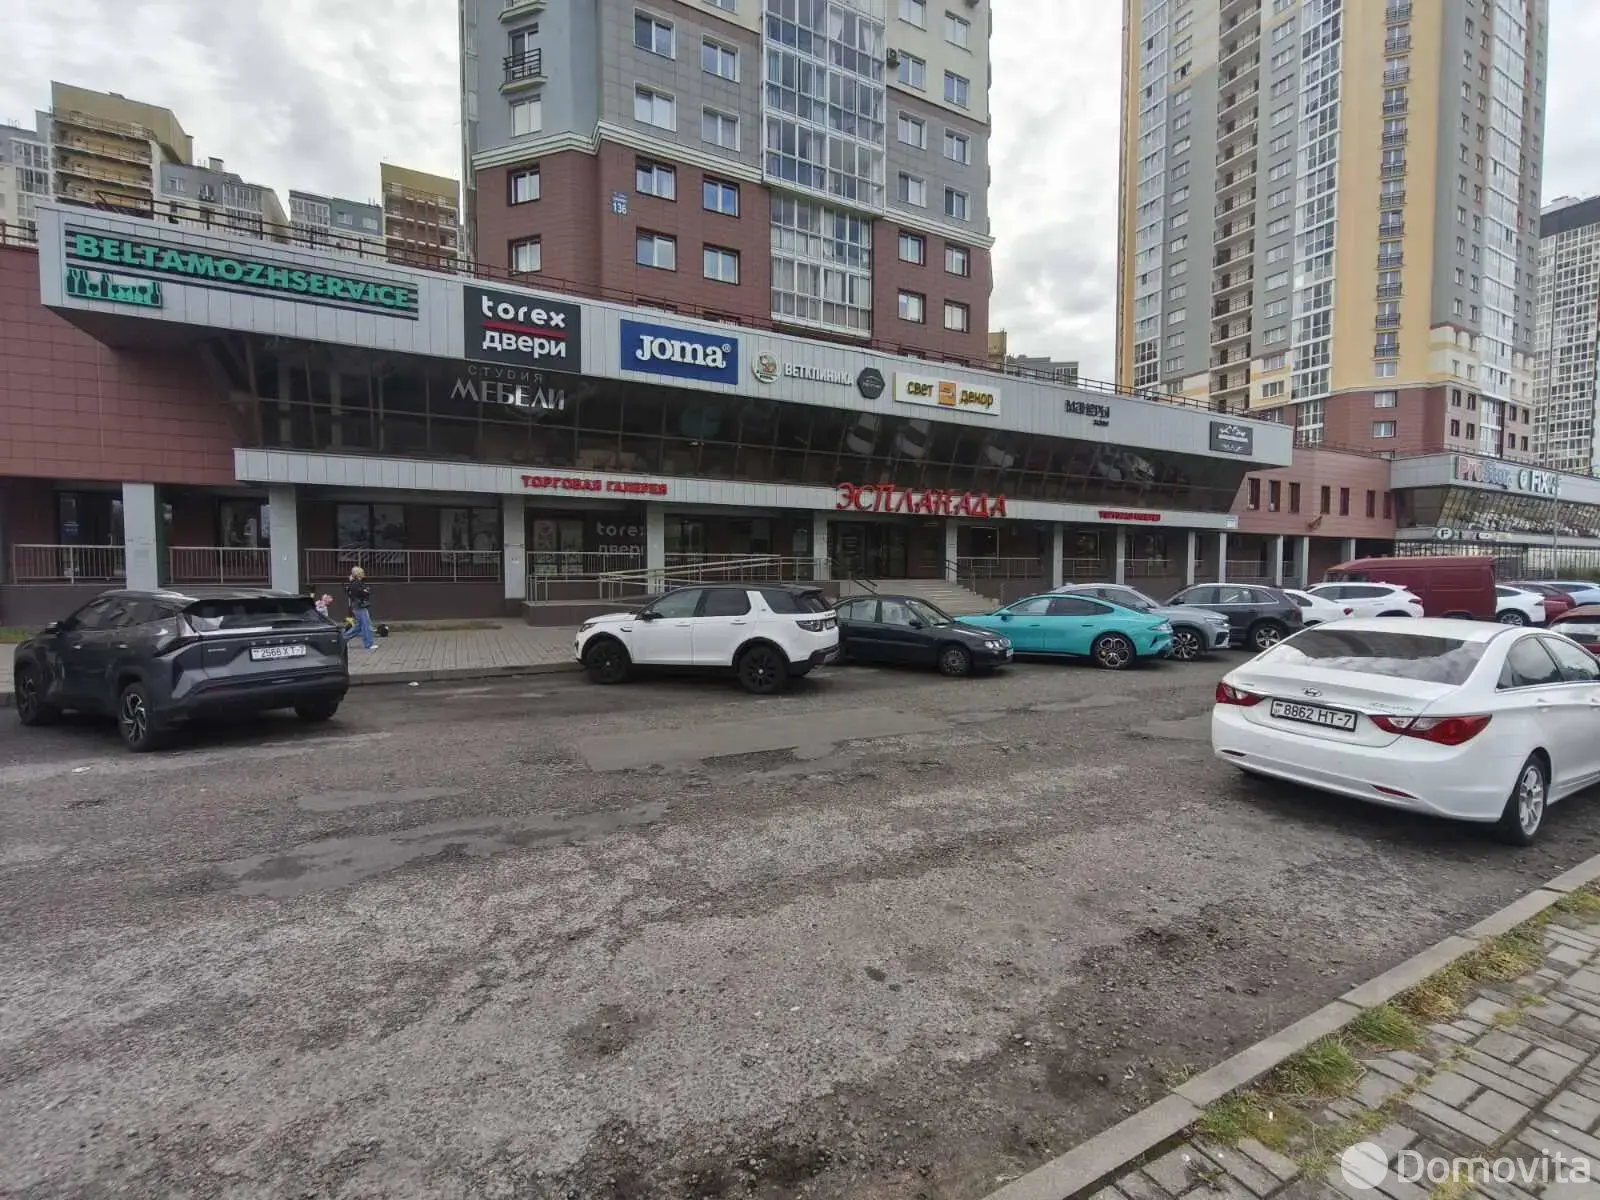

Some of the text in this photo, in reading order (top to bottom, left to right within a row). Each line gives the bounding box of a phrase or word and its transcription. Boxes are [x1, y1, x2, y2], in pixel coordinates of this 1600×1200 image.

[75, 232, 410, 309] BELTAMOZHSERVICE
[481, 295, 566, 328] torex
[482, 330, 567, 359] двери
[449, 377, 565, 411] МЕБЕЛИ
[521, 475, 602, 493] ТОРГОВАЯ
[835, 481, 1008, 518] ЭСПЛАНАДА
[1283, 704, 1314, 720] 8862
[1317, 710, 1353, 727] HT-7
